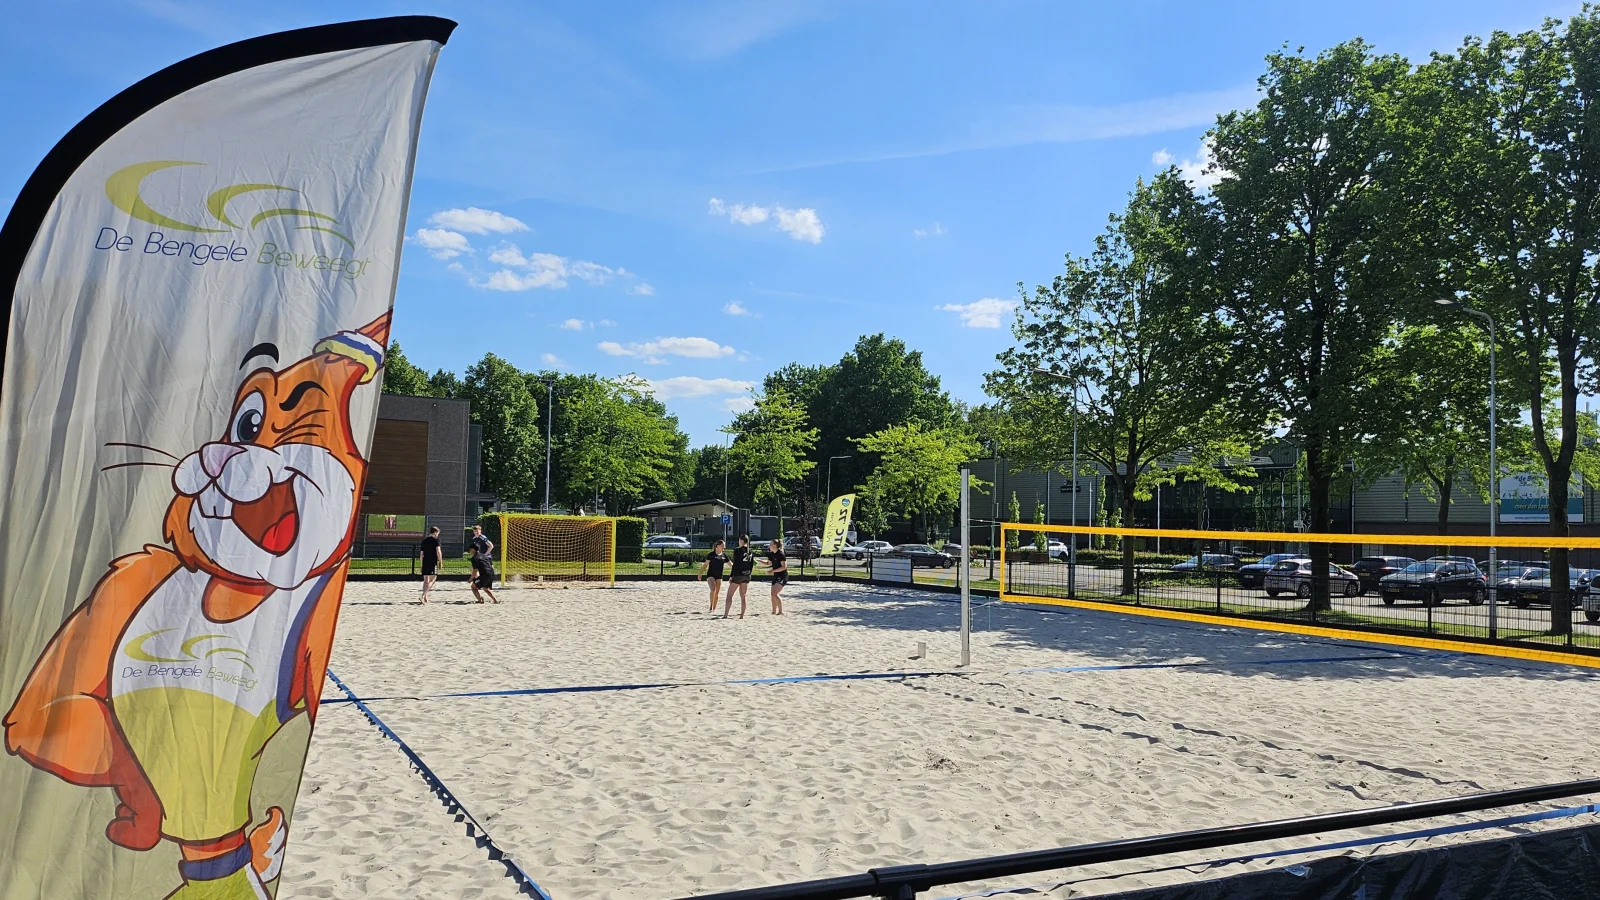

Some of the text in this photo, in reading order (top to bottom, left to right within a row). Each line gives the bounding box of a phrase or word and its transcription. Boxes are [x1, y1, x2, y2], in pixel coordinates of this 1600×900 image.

[95, 227, 372, 280] De Bengele Beweegt
[723, 515, 729, 524] P
[122, 665, 259, 691] De Bengele Beweegt
